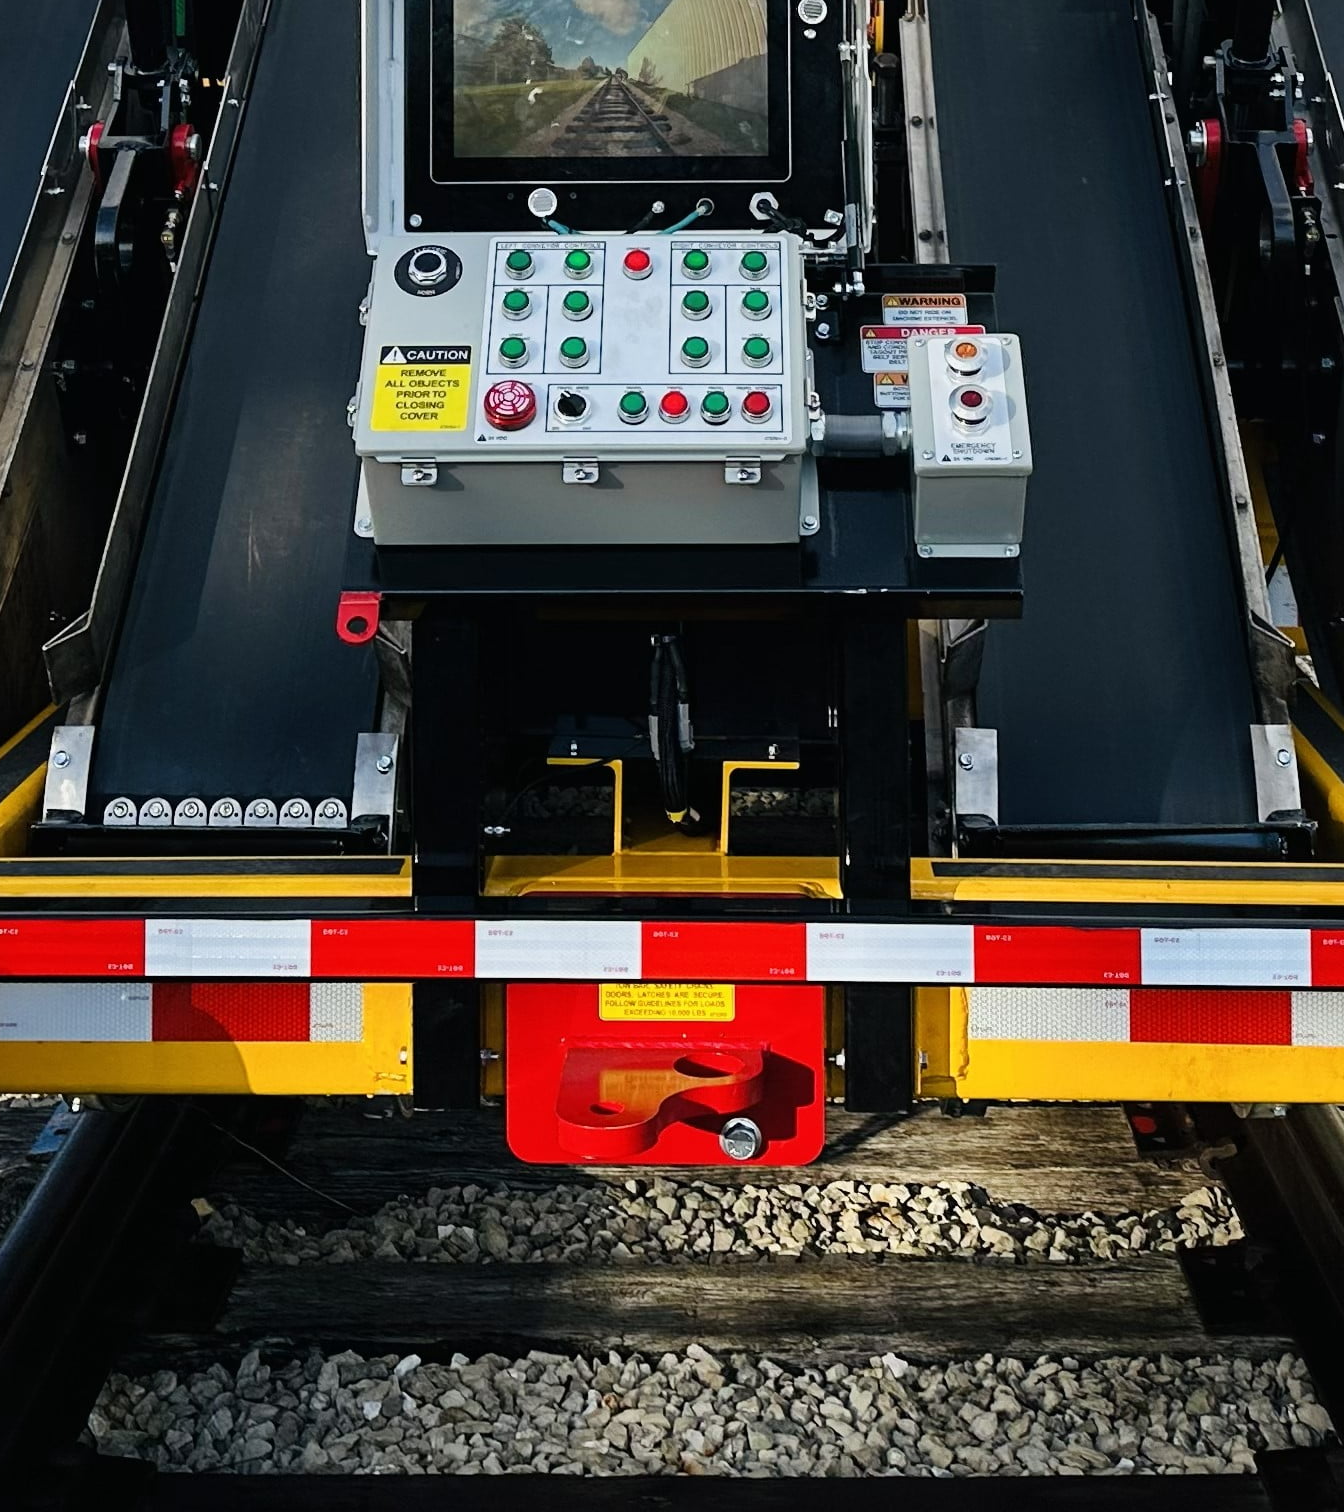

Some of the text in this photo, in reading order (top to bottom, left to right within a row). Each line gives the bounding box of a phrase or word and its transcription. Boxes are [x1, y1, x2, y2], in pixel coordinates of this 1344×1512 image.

[898, 297, 961, 306] WARNING
[900, 328, 956, 337] DANGER
[406, 350, 468, 360] CAUTION
[400, 369, 446, 377] REMOVE
[384, 379, 460, 388] ALL OBJECTS
[396, 390, 447, 398] PRIOR TO
[395, 401, 445, 409] CLOSING
[399, 412, 439, 420] COVER
[674, 991, 689, 999] ARE
[605, 999, 636, 1007] FOLLOW
